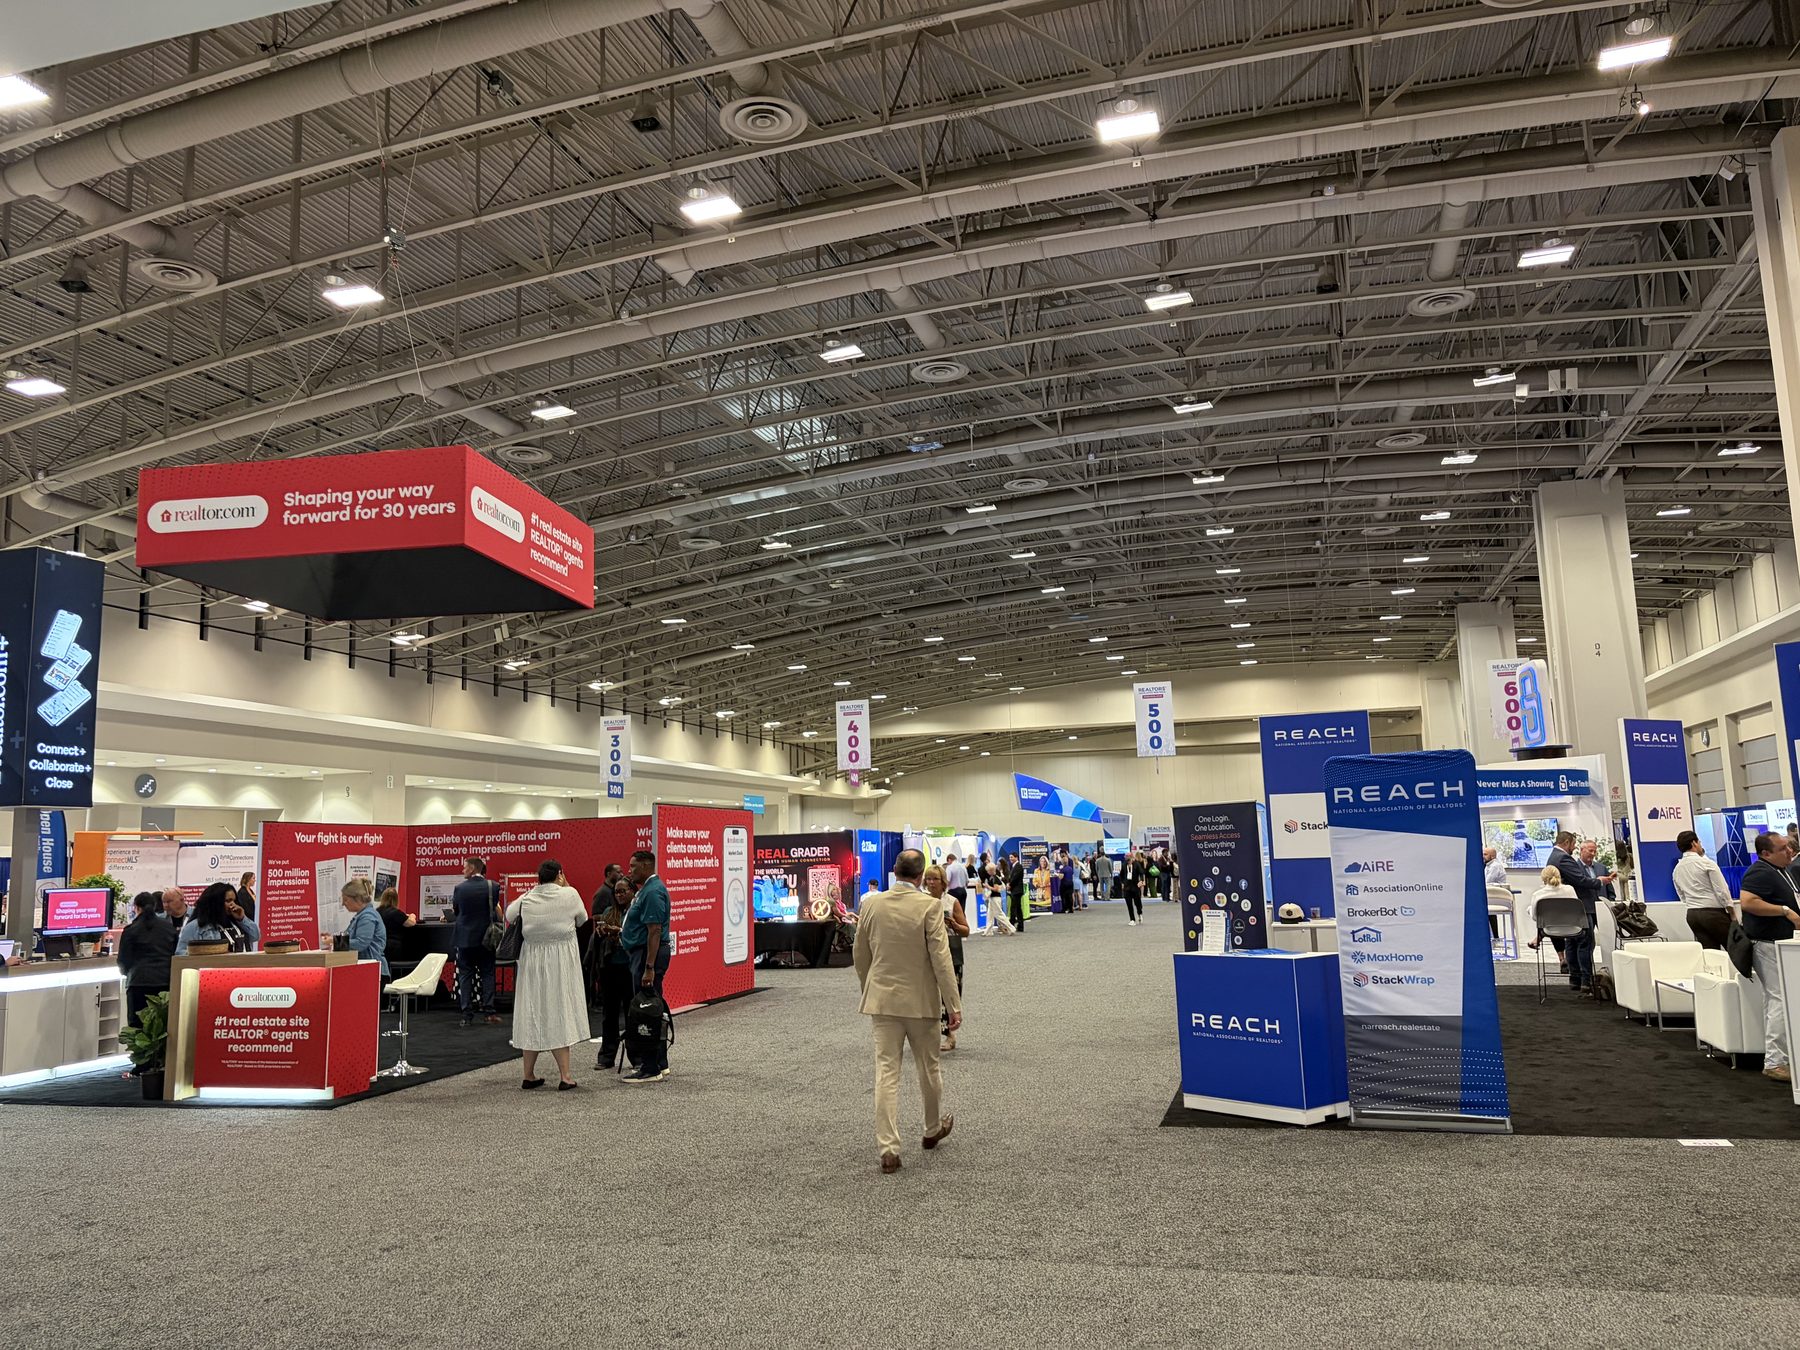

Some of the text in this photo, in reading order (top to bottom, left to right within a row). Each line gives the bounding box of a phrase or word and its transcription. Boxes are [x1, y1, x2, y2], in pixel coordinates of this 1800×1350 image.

[283, 484, 434, 507] Shaping your way
[174, 504, 257, 522] realtor.com
[283, 500, 456, 525] forward for 30 years
[483, 502, 521, 533] realtor.com
[530, 512, 583, 554] #1 real estate site
[530, 548, 569, 577] recommend
[563, 551, 584, 570] agents
[1503, 681, 1522, 731] 600
[1148, 703, 1163, 750] 500
[1274, 726, 1355, 741] REACH
[1632, 732, 1678, 743] REACH
[847, 720, 860, 763] 400
[610, 734, 621, 777] 300
[45, 776, 74, 789] Close
[1476, 779, 1555, 789] Never Miss A Showing
[609, 785, 622, 795] 300
[1333, 779, 1465, 804] REACH
[1369, 804, 1414, 813] ASSOCIATION
[1659, 806, 1682, 820] AiRE
[1198, 814, 1230, 824] One Login.
[666, 826, 710, 841] Make sure your
[1194, 823, 1235, 832] One Location.
[294, 832, 383, 846] Your fight is our fight
[416, 830, 561, 845] Complete your profile and earn
[1190, 833, 1219, 841] Seamless
[416, 842, 547, 856] 500% more impressions and
[636, 839, 646, 848] in
[666, 841, 714, 856] clients are ready
[1204, 841, 1236, 850] Everything
[41, 836, 54, 874] House
[757, 846, 830, 859] REAL GRADER
[1213, 849, 1232, 857] Need.
[415, 857, 459, 867] 75% more
[666, 856, 720, 868] when the market is
[1361, 861, 1395, 873] AiRE
[267, 868, 284, 878] 500
[284, 867, 310, 877] million
[267, 877, 310, 887] impressions
[1363, 883, 1443, 893] AssociationOnline
[87, 906, 97, 914] way
[87, 912, 101, 920] years
[1347, 907, 1398, 917] BrokerBot
[679, 929, 695, 937] Download
[678, 945, 700, 955] Market Clock
[1366, 952, 1424, 962] MaxHome
[1371, 975, 1435, 986] StackWrap
[244, 991, 290, 1002] realtor.com
[214, 1015, 310, 1026] #1 real estate site
[1191, 1012, 1280, 1034] REACH
[1361, 1023, 1441, 1032] narreach.realestate
[213, 1028, 310, 1041] REALTOR® agents
[227, 1041, 293, 1053] recommend
